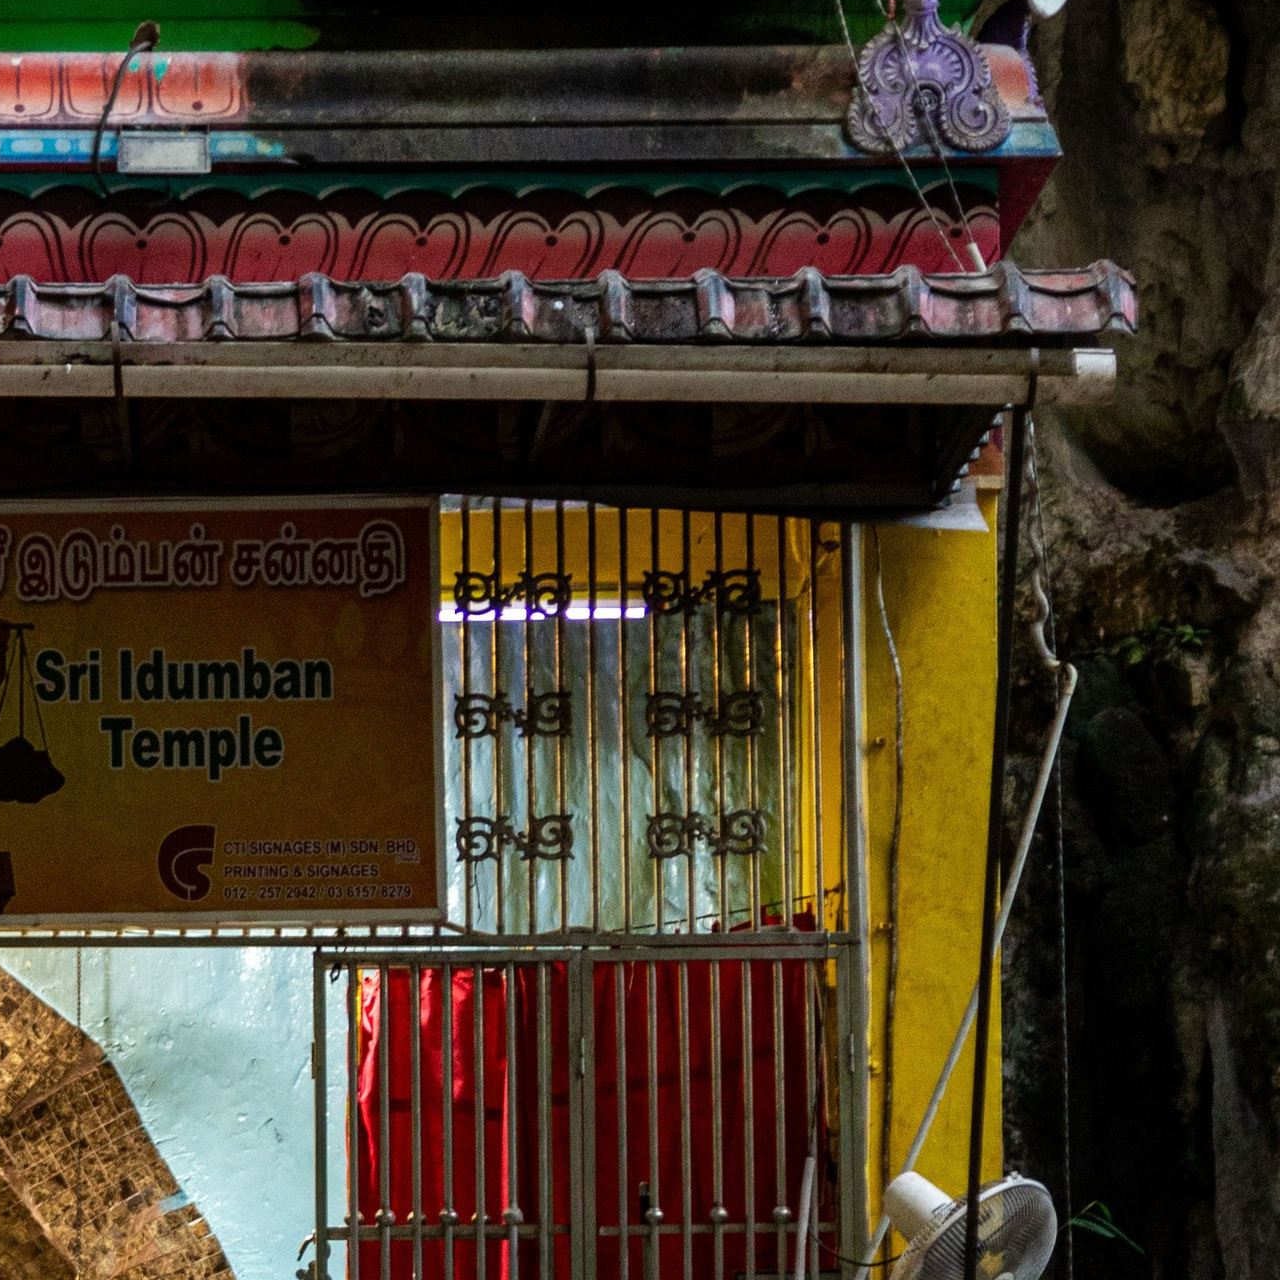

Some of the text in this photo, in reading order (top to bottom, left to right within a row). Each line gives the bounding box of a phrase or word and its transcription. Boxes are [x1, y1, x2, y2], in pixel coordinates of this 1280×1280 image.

[18, 523, 222, 601] இடும்பன்
[232, 520, 405, 597] சன்னதி
[35, 646, 334, 703] Sri Idumban
[100, 714, 284, 782] Temple
[249, 840, 322, 855] SIGNAGES
[325, 840, 347, 856] (M)
[223, 864, 380, 879] PRINTING & SIGNAGES
[223, 886, 248, 899] 012
[259, 886, 282, 899] 257
[285, 885, 316, 899] 2942
[327, 885, 343, 898] 03
[346, 885, 377, 898] 6157
[380, 884, 413, 898] 8279
